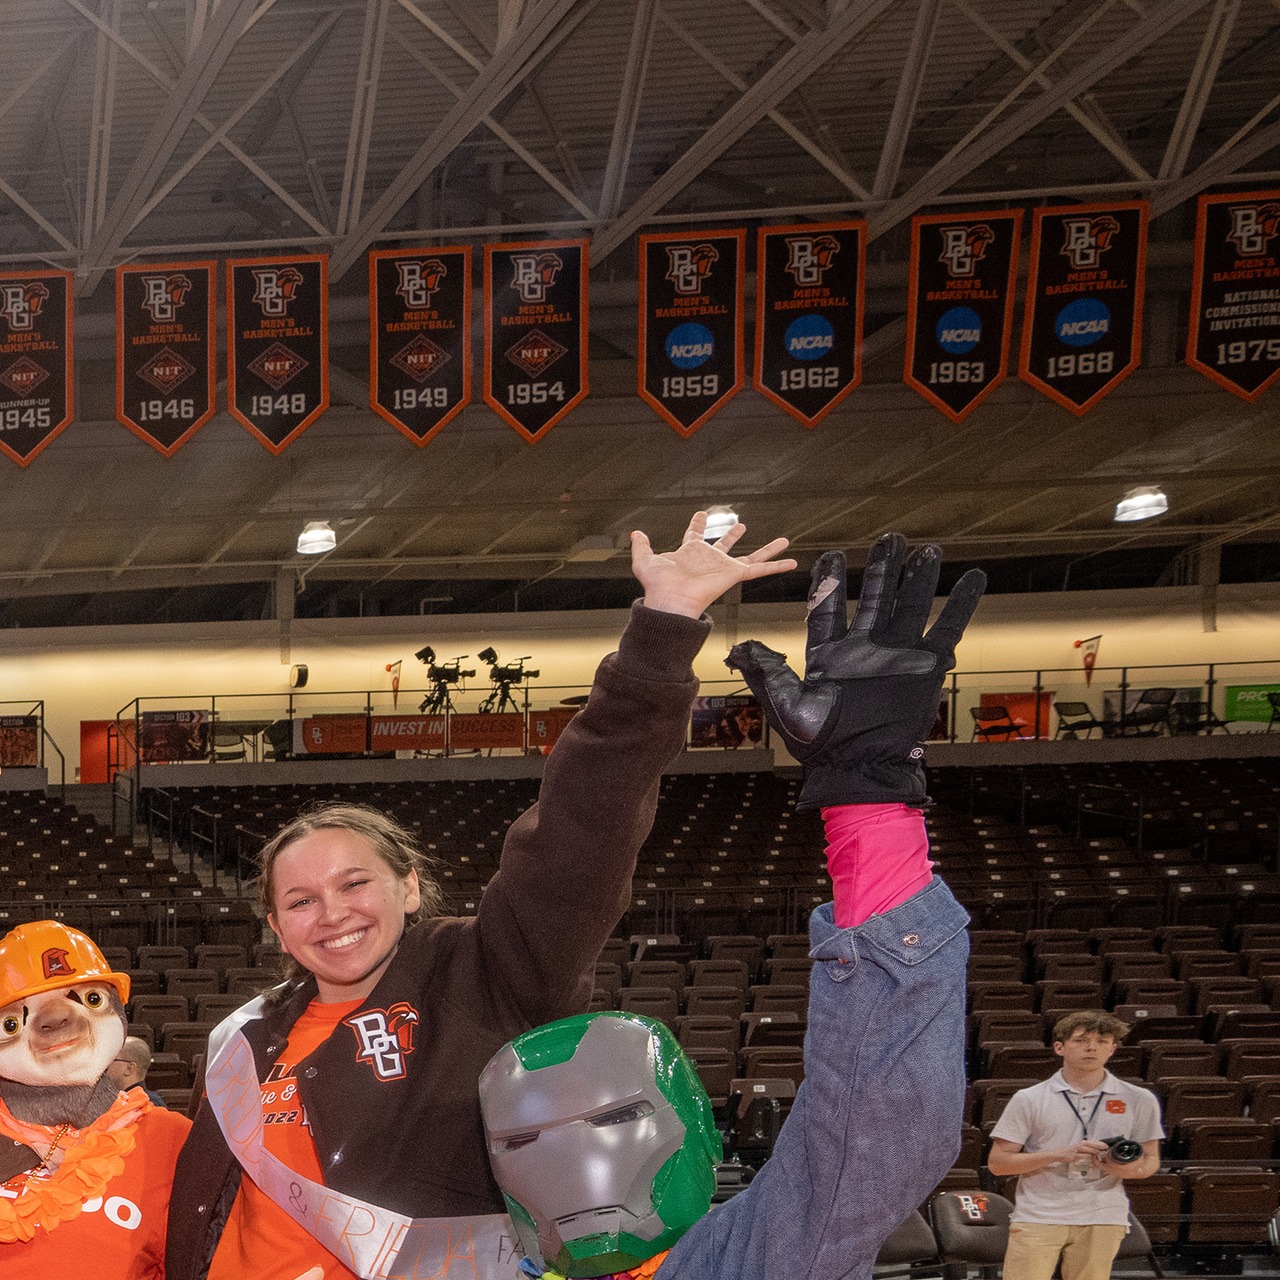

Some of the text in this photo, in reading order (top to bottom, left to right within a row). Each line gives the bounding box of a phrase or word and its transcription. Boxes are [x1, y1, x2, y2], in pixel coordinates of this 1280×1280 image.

[1068, 270, 1109, 282] MEN'S
[946, 279, 981, 288] MEN'S
[1045, 279, 1128, 295] BASKETBALL
[793, 288, 830, 299] MEN'S
[927, 289, 998, 300] BASKETBALL
[673, 295, 710, 306] MEN'S
[774, 298, 848, 311] BASKETBALL
[404, 310, 438, 320] MEN'S
[519, 304, 554, 315] MEN'S
[655, 305, 728, 318] BASKETBALL
[261, 318, 295, 328] MEN'S
[501, 313, 573, 326] BASKETBALL
[149, 324, 183, 334] MEN'S
[386, 320, 455, 332] BASKETBALL
[1060, 319, 1109, 336] NCAA
[7, 332, 41, 343] MEN'S
[132, 333, 200, 345] BASKETBALL
[243, 327, 313, 339] BASKETBALL
[941, 329, 981, 342] NCAA
[790, 335, 833, 350] NCAA
[521, 348, 551, 359] NIT
[671, 343, 713, 358] NCAA
[1217, 339, 1280, 365] 1975
[407, 353, 436, 364] NIT
[1047, 351, 1115, 378] 1968
[153, 366, 182, 376] NIT
[264, 361, 293, 371] NIT
[12, 372, 38, 382] NIT
[929, 361, 985, 384] 1963
[781, 367, 839, 391] 1962
[662, 374, 718, 398] 1959
[394, 387, 448, 410] 1949
[508, 381, 565, 405] 1954
[140, 399, 194, 421] 1946
[251, 393, 306, 416] 1948
[176, 711, 191, 722] 103
[374, 721, 426, 736] INVEST
[427, 719, 444, 734] IN
